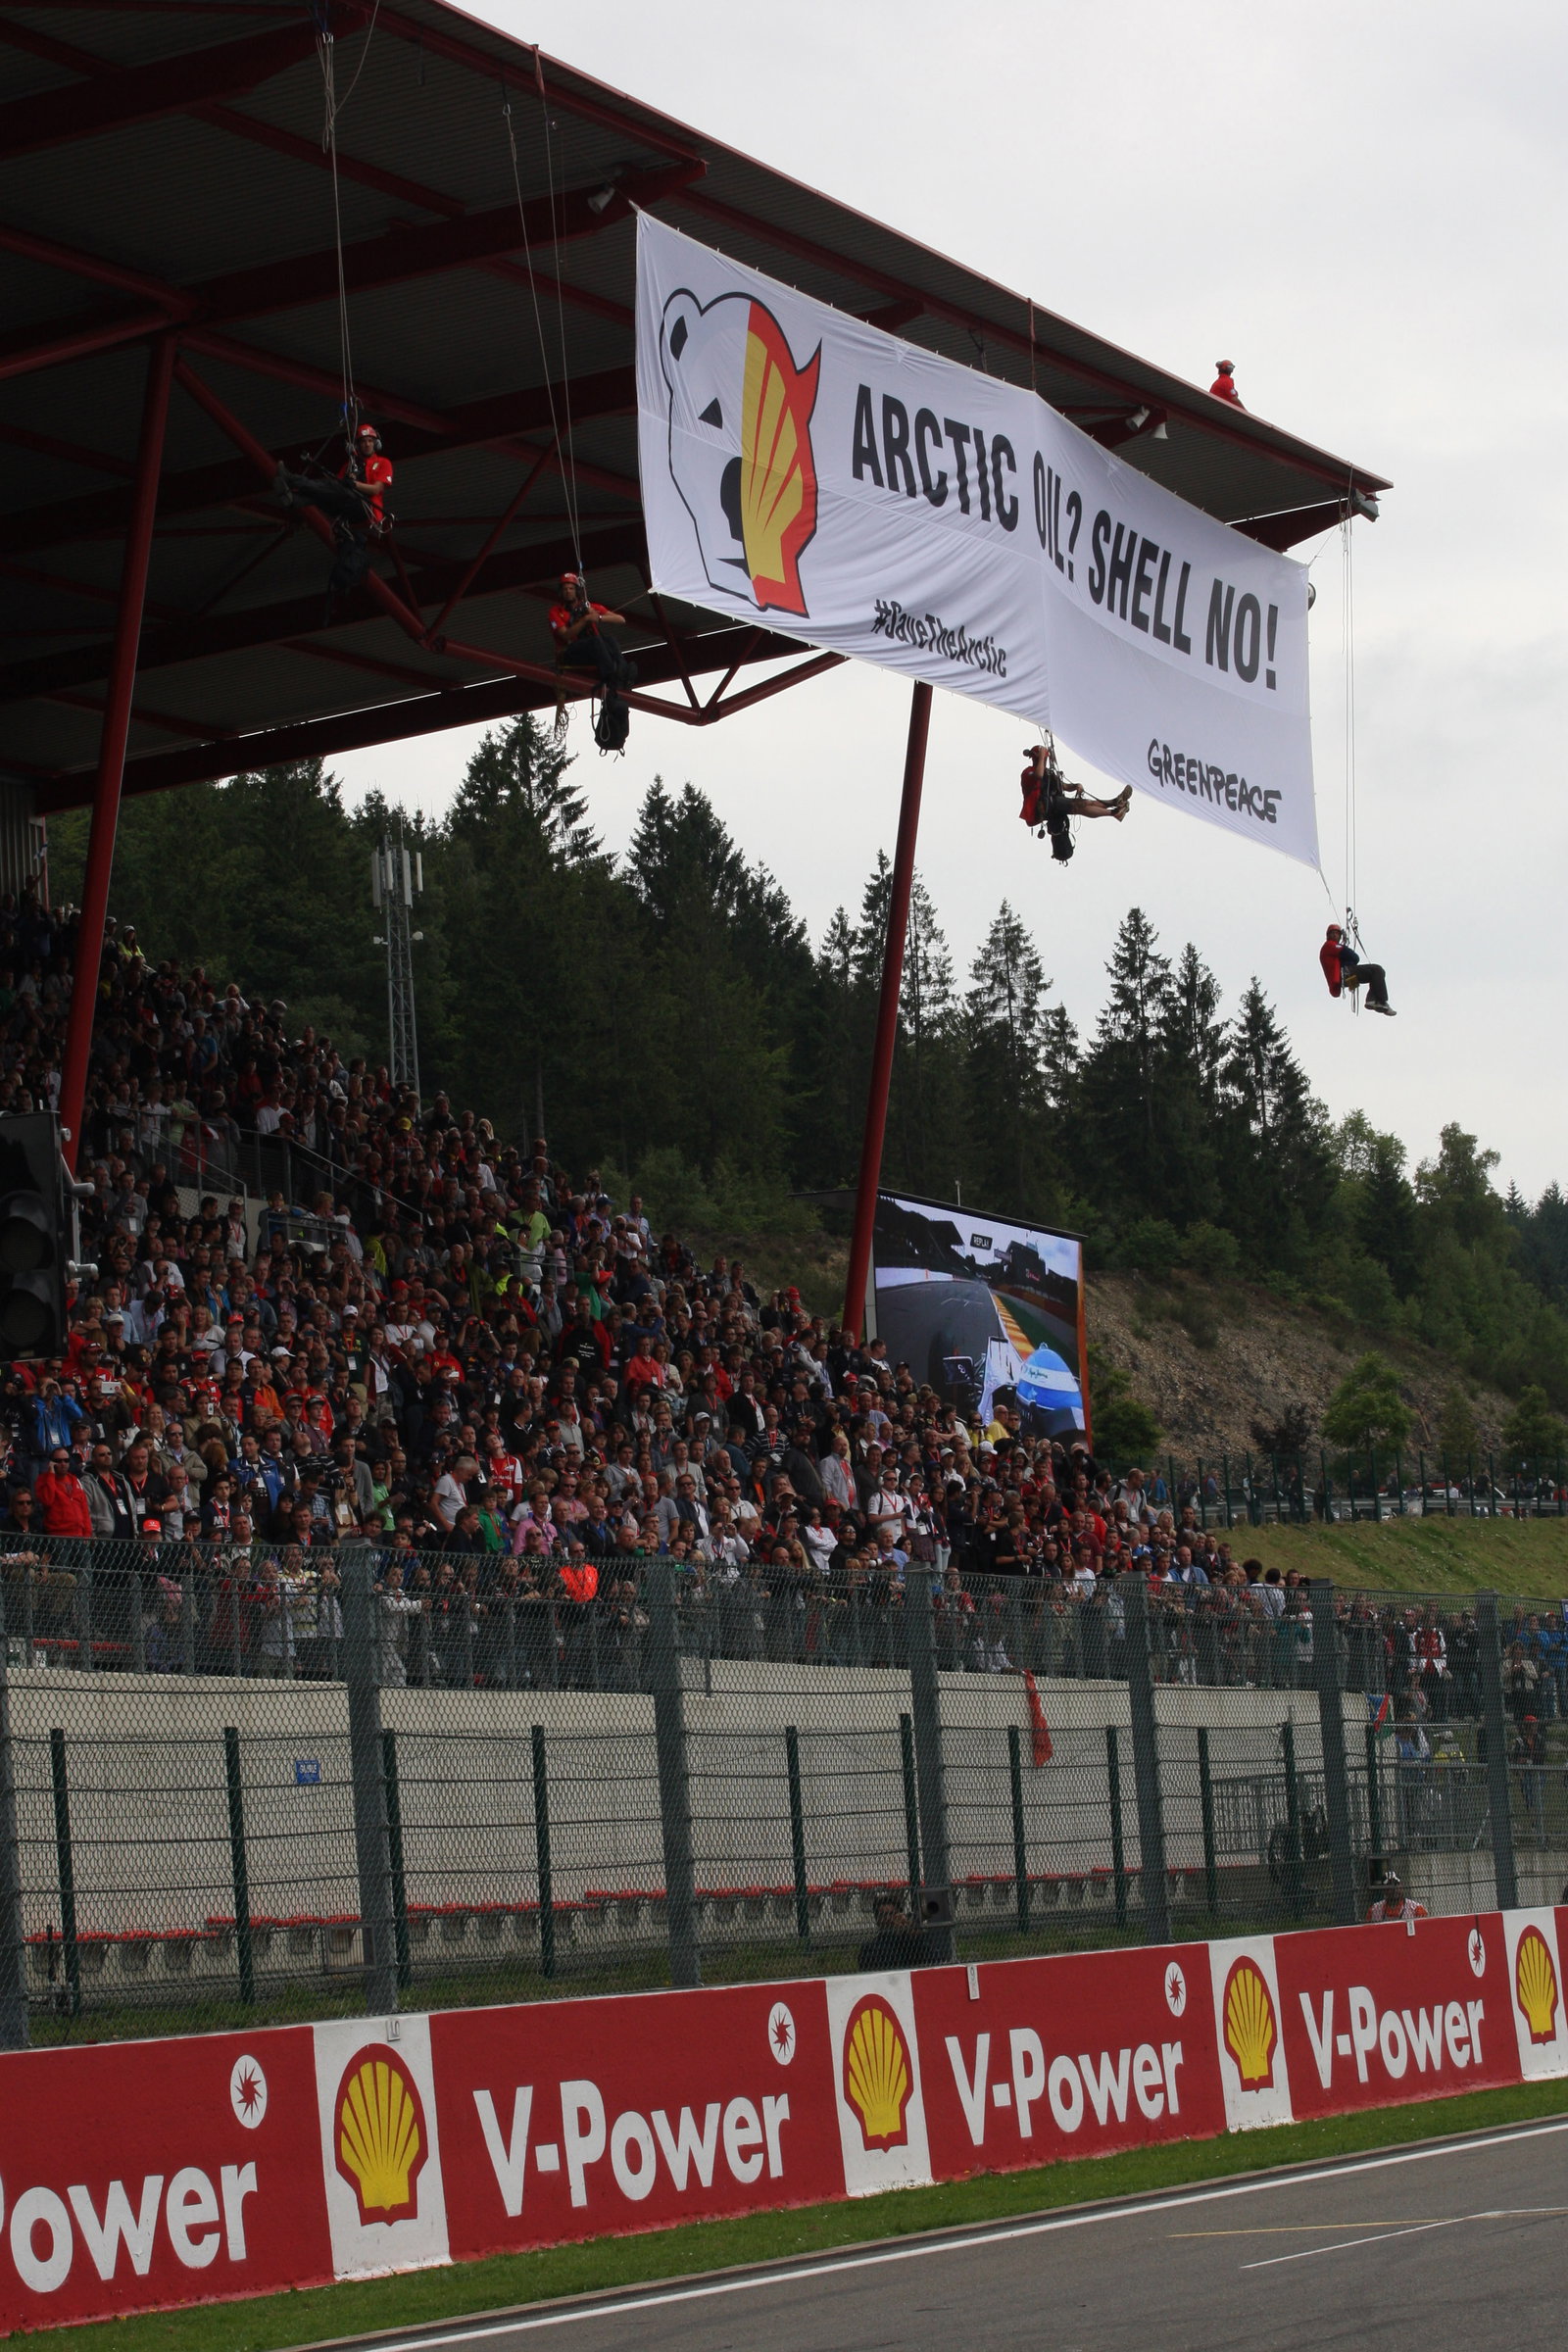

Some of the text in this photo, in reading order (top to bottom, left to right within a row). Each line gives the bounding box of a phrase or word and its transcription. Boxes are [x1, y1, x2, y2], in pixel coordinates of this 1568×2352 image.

[852, 383, 1279, 691] ARCTIC OIL? SHELL NO!
[870, 599, 1006, 678] #SaveTheArctic
[1148, 738, 1282, 824] GREENPEACE
[944, 2027, 1184, 2146] V-Power
[1298, 1986, 1485, 2089] V-Power
[472, 2080, 792, 2218] V-Power
[0, 2161, 258, 2293] ower
